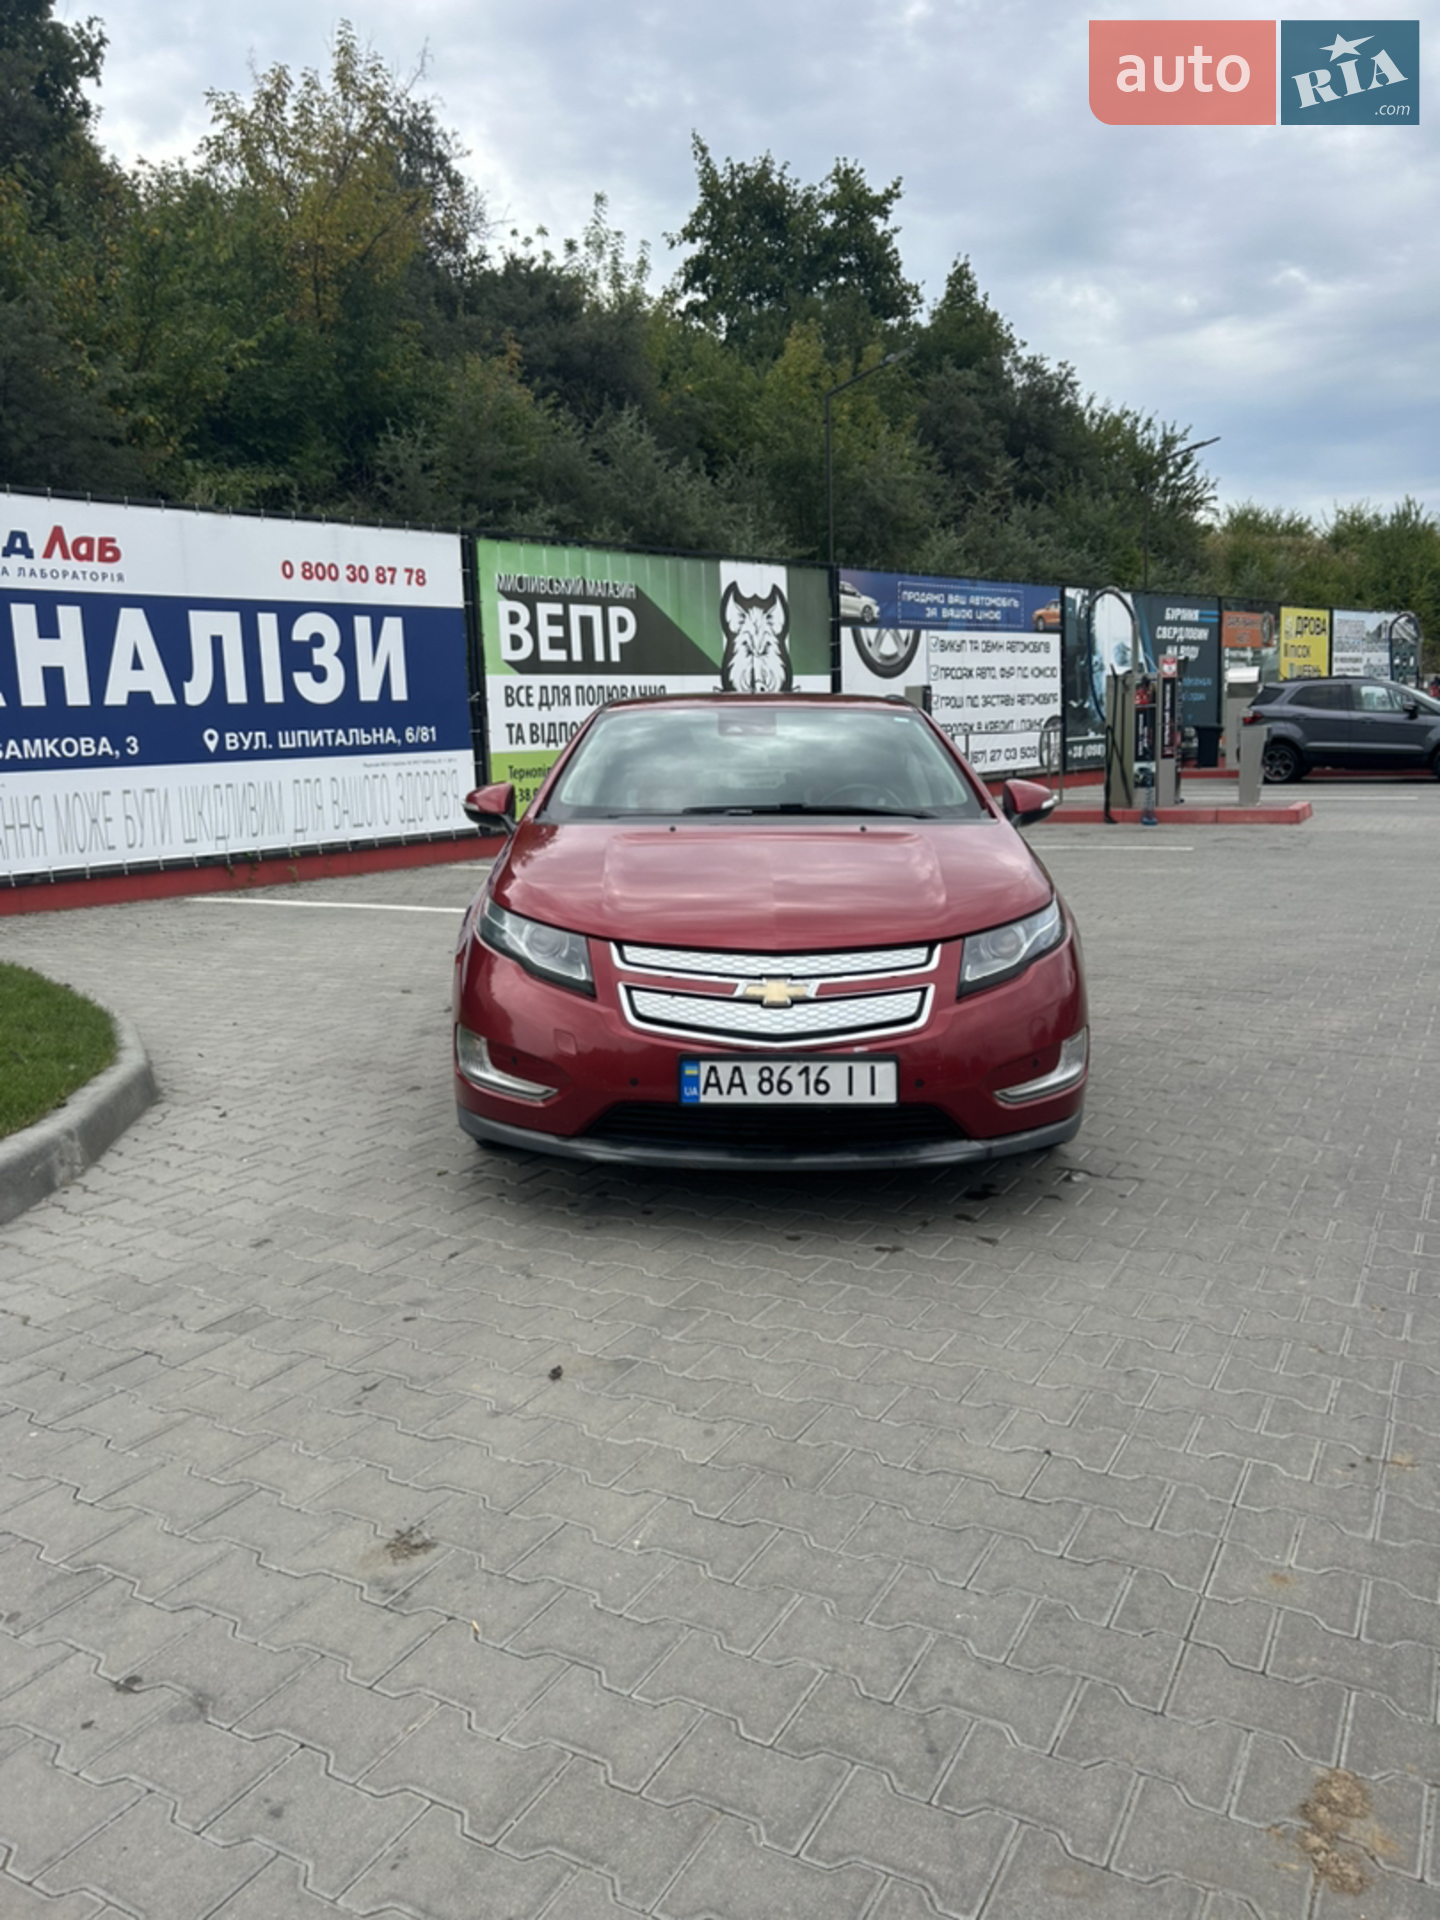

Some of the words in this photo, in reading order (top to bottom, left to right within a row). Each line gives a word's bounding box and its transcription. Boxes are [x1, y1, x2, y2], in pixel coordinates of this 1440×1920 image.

[17, 566, 125, 583] ЛАБОРАТОРІЯ
[281, 560, 294, 580] 0
[301, 561, 339, 582] 800
[345, 564, 369, 584] 30
[375, 565, 397, 585] 87
[404, 567, 426, 587] 78
[586, 579, 637, 599] МАГАЗИН
[497, 600, 637, 662] ВЕПР
[0, 602, 408, 707] НАЛІЗИ
[504, 685, 534, 708] ВСЕ
[538, 685, 572, 711] ДЛЯ
[0, 737, 120, 760] АМКОВА,
[125, 735, 139, 756] 3
[224, 731, 273, 750] ВУЛ.
[278, 727, 402, 748] ШПИТАЛЬНА,
[405, 726, 437, 744] 6/81
[506, 723, 526, 745] ТА
[529, 721, 585, 748] ВІДПО
[53, 791, 116, 855] МОЖЕ
[122, 787, 172, 849] БУТИ
[293, 777, 326, 841] ДЛЯ
[330, 773, 391, 829] ВАШОГО
[684, 1086, 698, 1097] UA
[702, 1065, 747, 1096] AA
[757, 1065, 831, 1096] 8616
[848, 1065, 876, 1096] II
